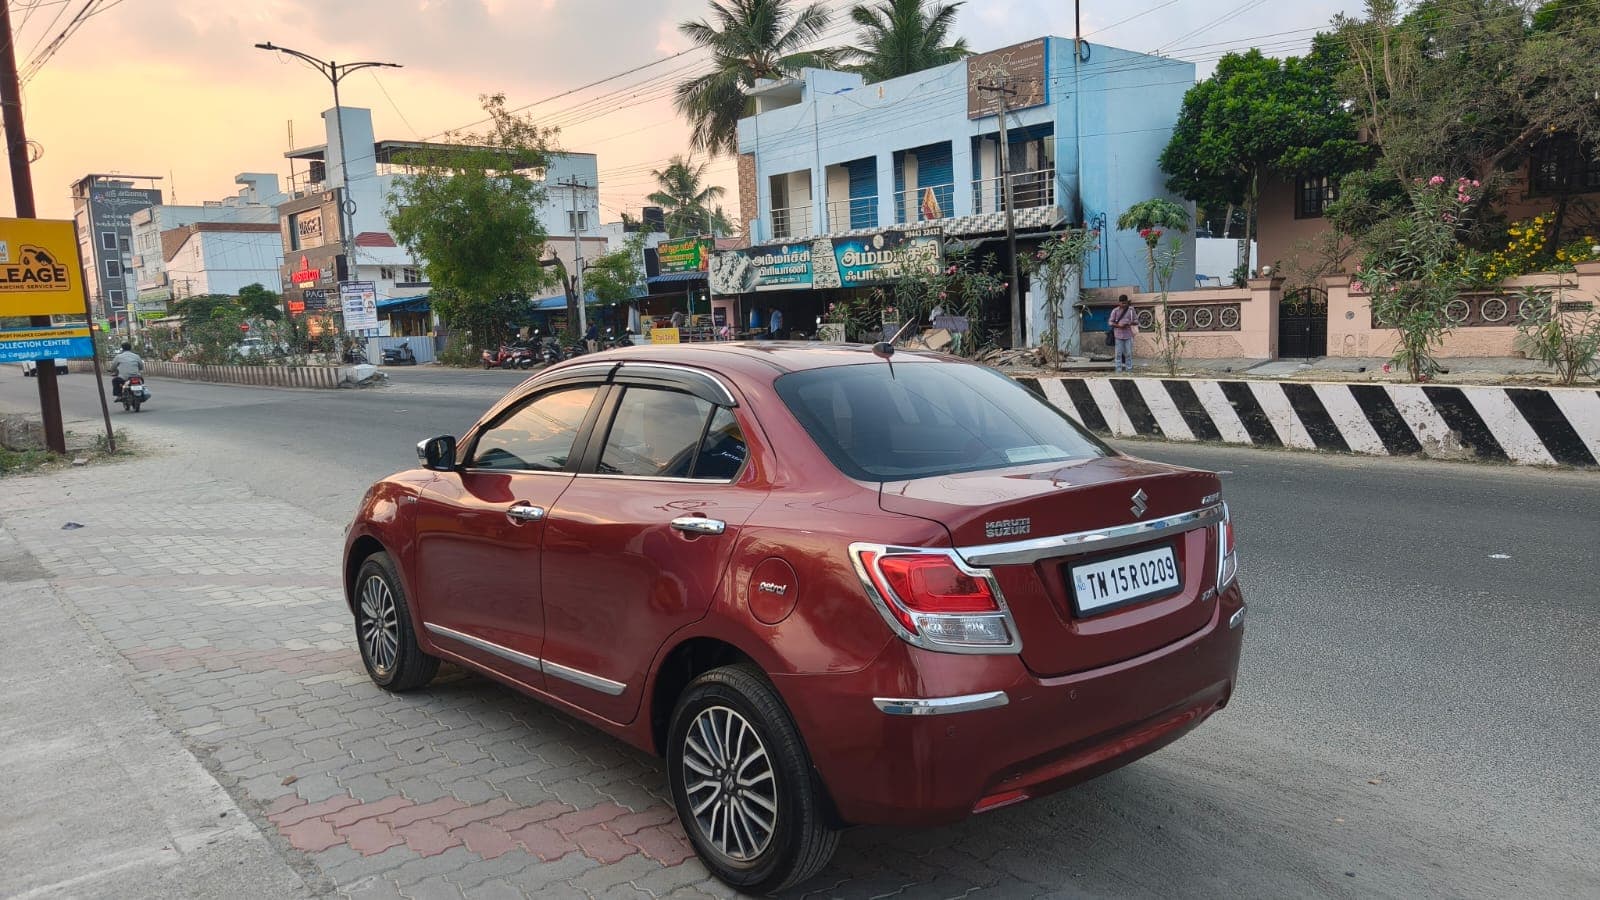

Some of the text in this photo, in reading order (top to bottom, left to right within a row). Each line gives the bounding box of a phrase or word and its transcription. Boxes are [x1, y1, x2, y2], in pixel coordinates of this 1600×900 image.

[42, 339, 71, 347] CENTRE
[985, 517, 1031, 529] MARUTI
[985, 525, 1031, 538] SUZUKI
[759, 581, 787, 595] petrol
